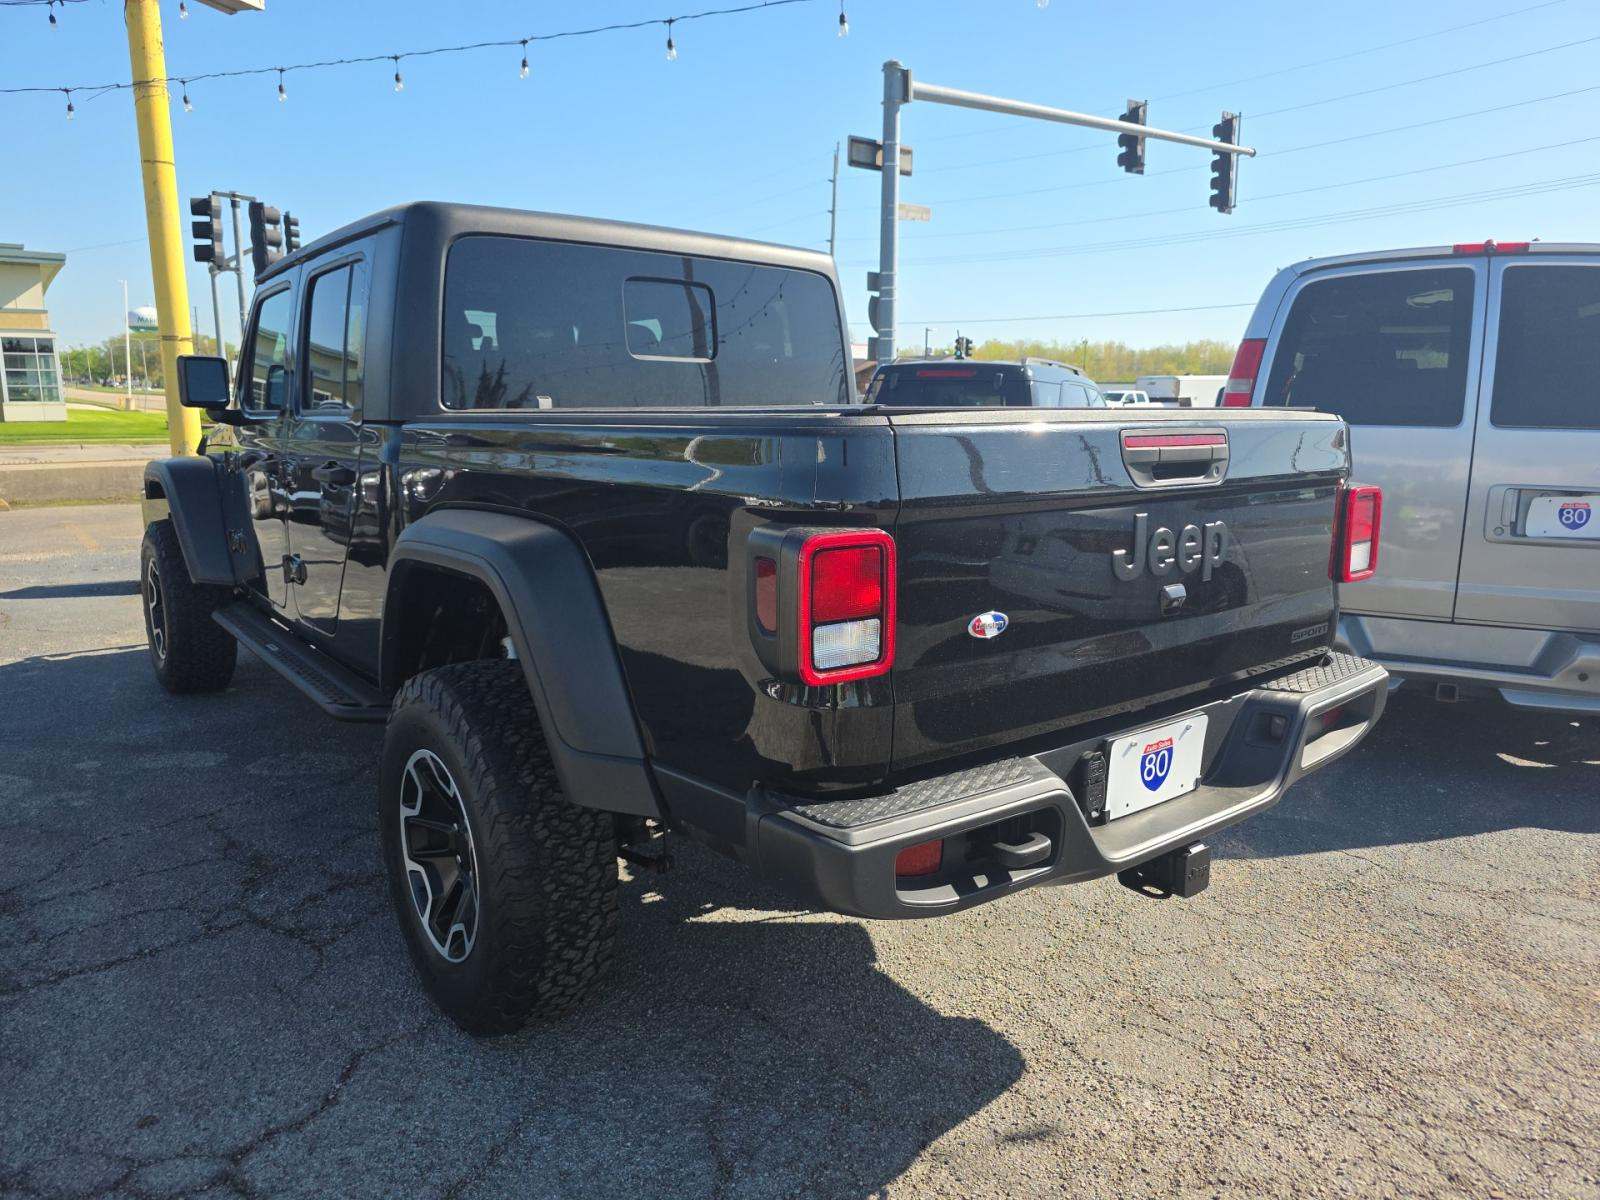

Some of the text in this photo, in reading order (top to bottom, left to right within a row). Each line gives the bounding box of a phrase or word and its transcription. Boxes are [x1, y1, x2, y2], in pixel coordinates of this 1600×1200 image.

[1562, 508, 1587, 524] 80
[1111, 512, 1229, 582] Jeep
[1143, 750, 1169, 781] 80
